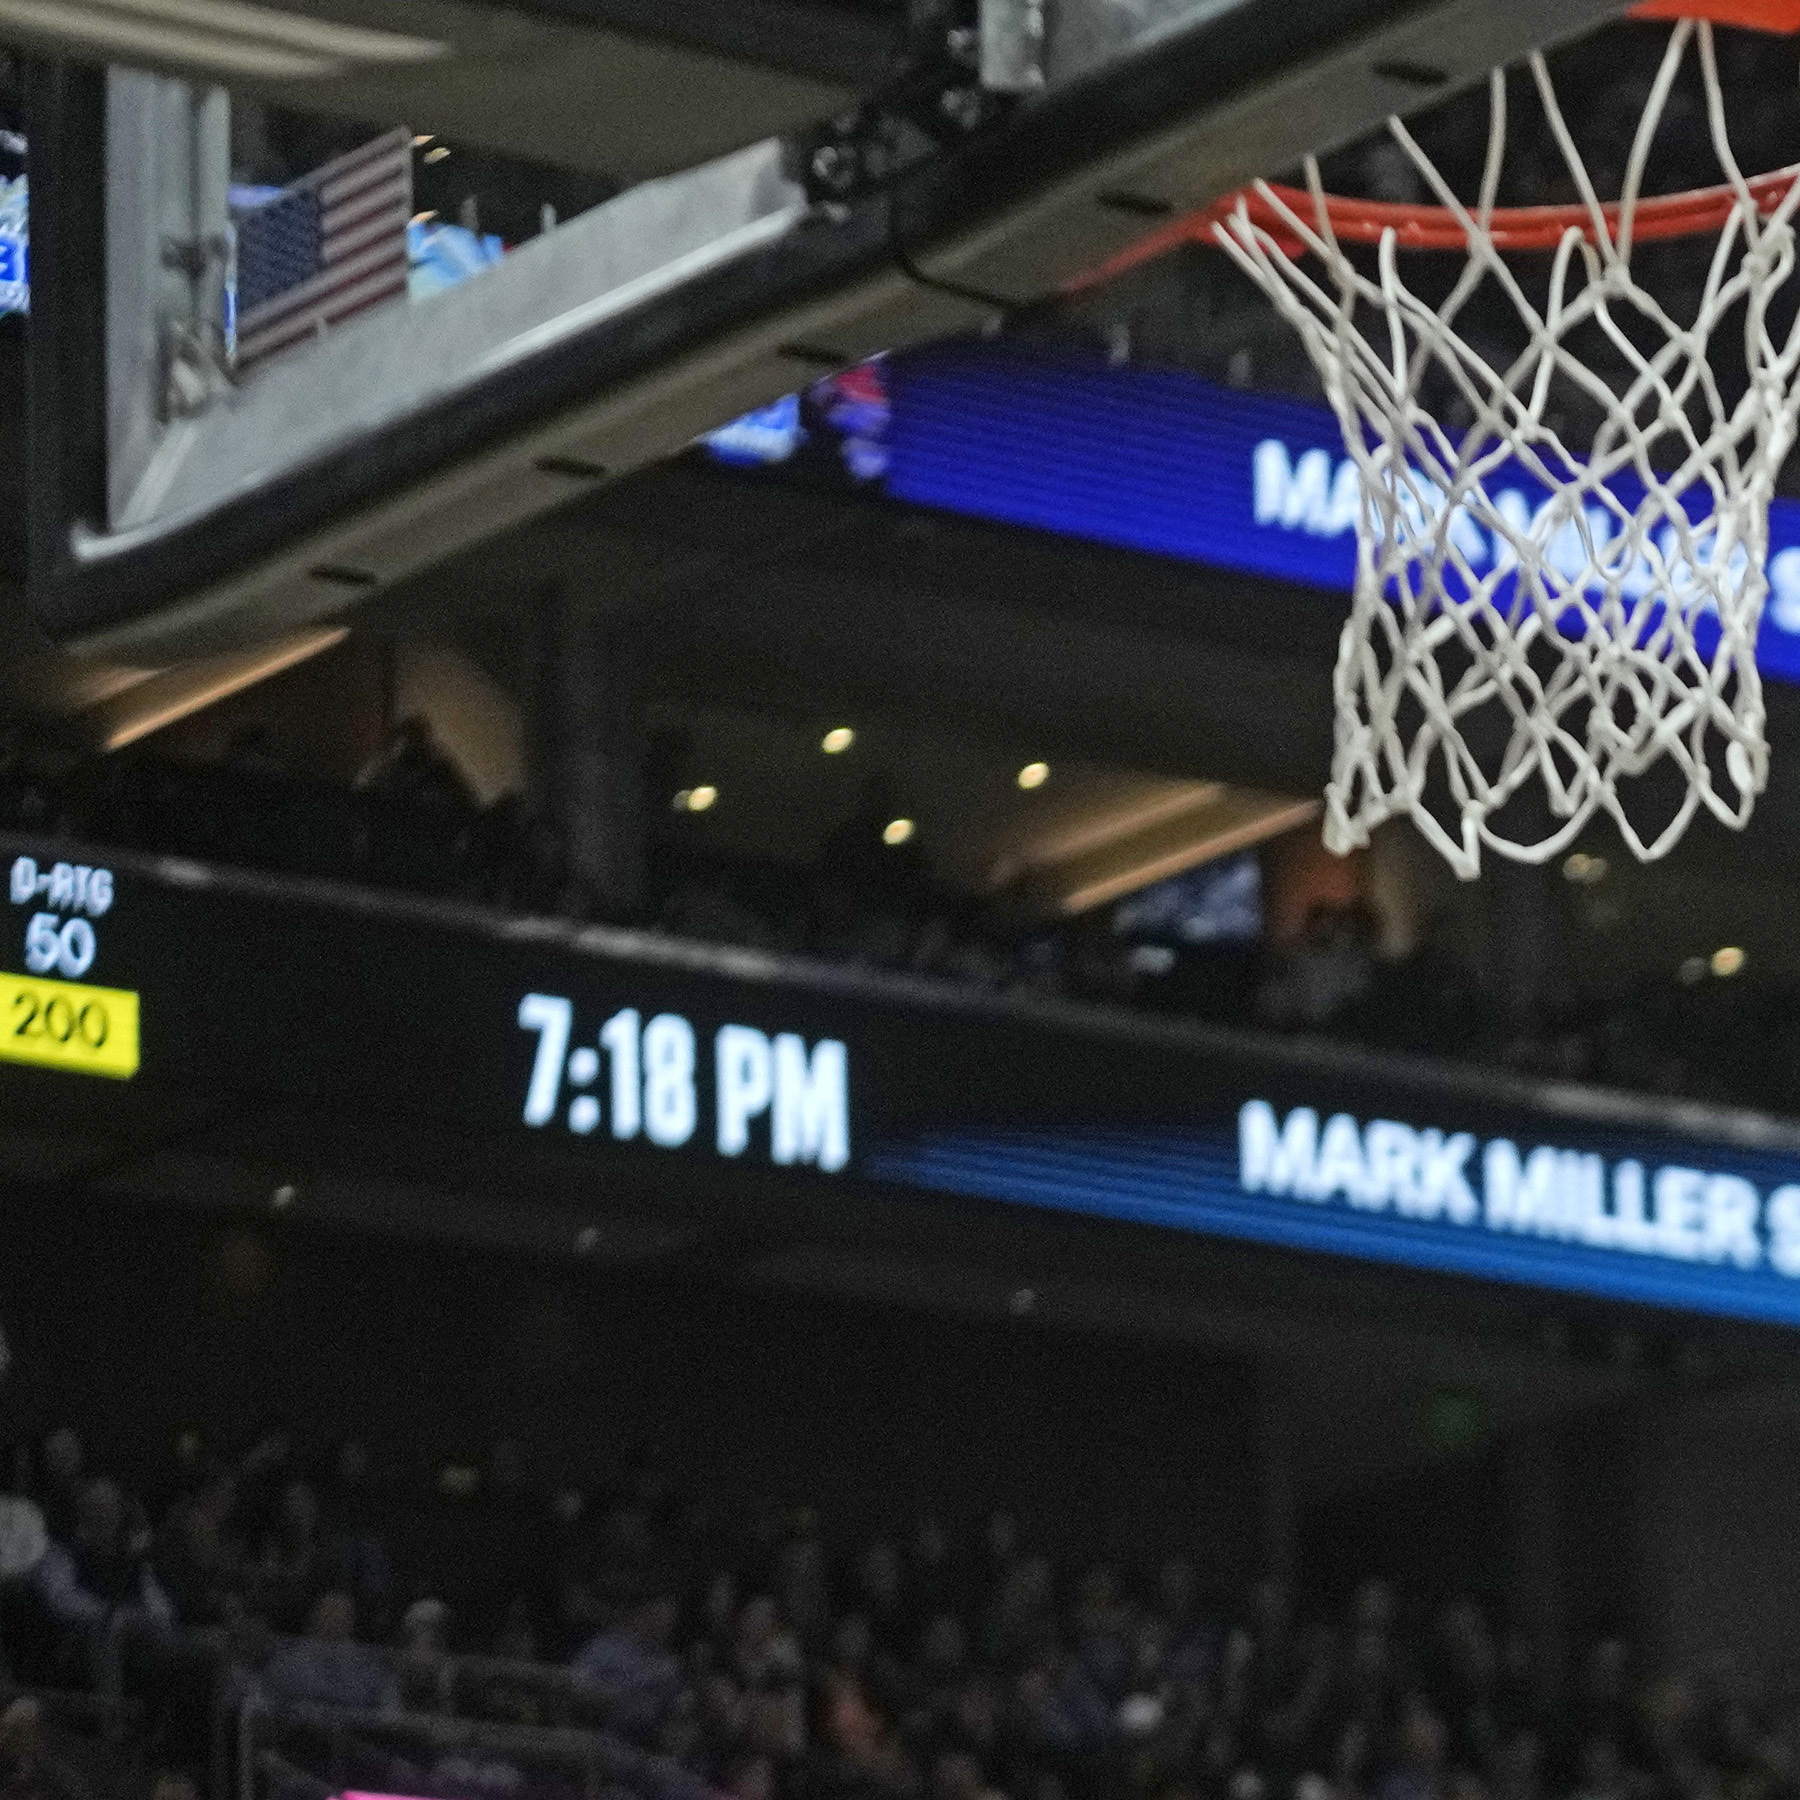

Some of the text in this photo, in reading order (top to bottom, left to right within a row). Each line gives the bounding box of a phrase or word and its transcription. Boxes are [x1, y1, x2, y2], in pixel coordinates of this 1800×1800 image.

[14, 990, 109, 1049] 200
[519, 993, 849, 1171] 7:18 PM
[1239, 1099, 1478, 1225] MARK
[1482, 1138, 1764, 1268] MILLER
